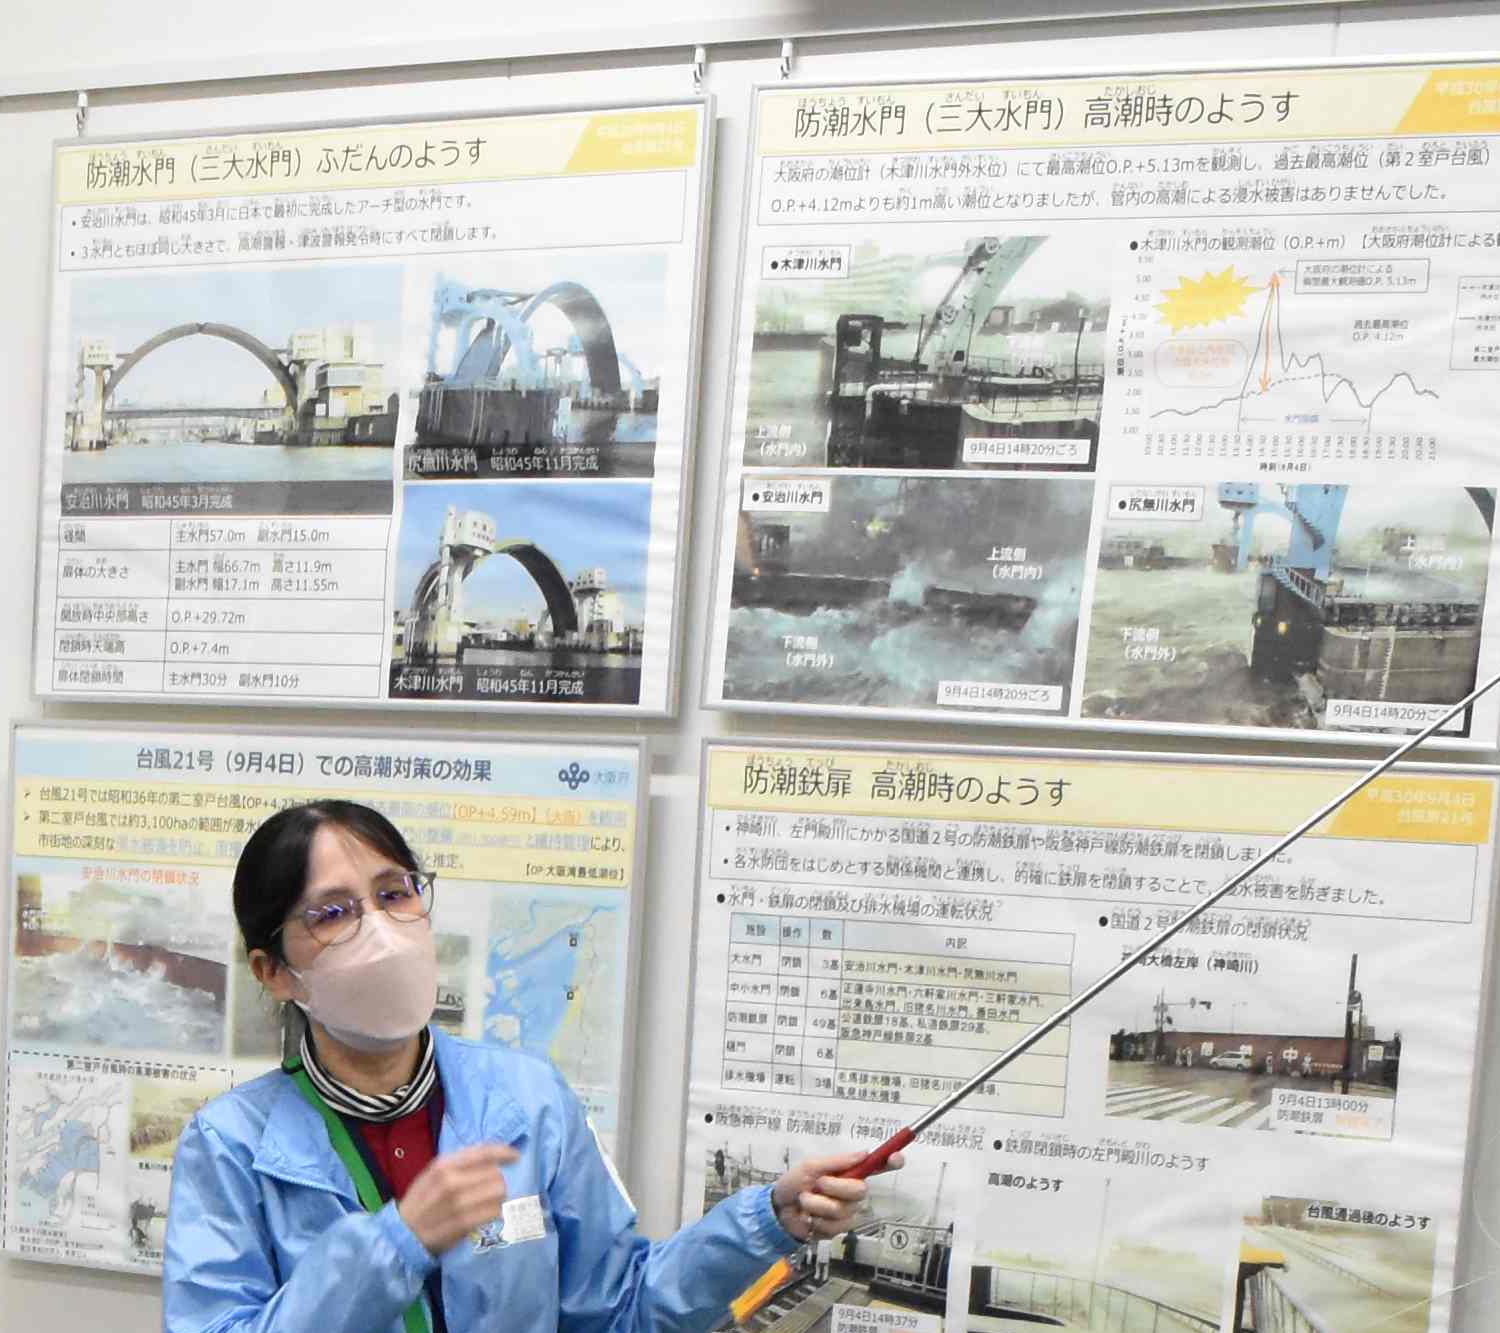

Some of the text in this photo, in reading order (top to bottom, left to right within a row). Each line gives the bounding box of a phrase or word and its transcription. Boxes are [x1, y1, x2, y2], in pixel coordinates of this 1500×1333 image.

[794, 89, 1300, 139] 防潮水門（三大水門）高潮時のようす
[86, 137, 487, 189] 防潮水門（三大水門）ふだんのようす
[781, 256, 842, 272] 木津川水門
[969, 442, 1078, 457] 9月4日14時20分ごろ
[490, 453, 600, 472] 昭和45年11月完成
[762, 490, 823, 505] 安治川水門
[393, 674, 585, 696] 木津川水門 昭和45年11月完成
[944, 685, 1050, 701] 9月4日14時20分ごろ
[1332, 704, 1453, 722] 9月4日14時20分ご
[136, 748, 493, 782] 台風21号（9月4日）での高潮対策の効果
[742, 763, 1073, 809] 防潮鉄扉 高潮時のようす
[714, 1110, 782, 1134] 阪急神戸線
[986, 1173, 1065, 1192] 高潮のようす
[1306, 1204, 1433, 1230] 台風通過後のようす
